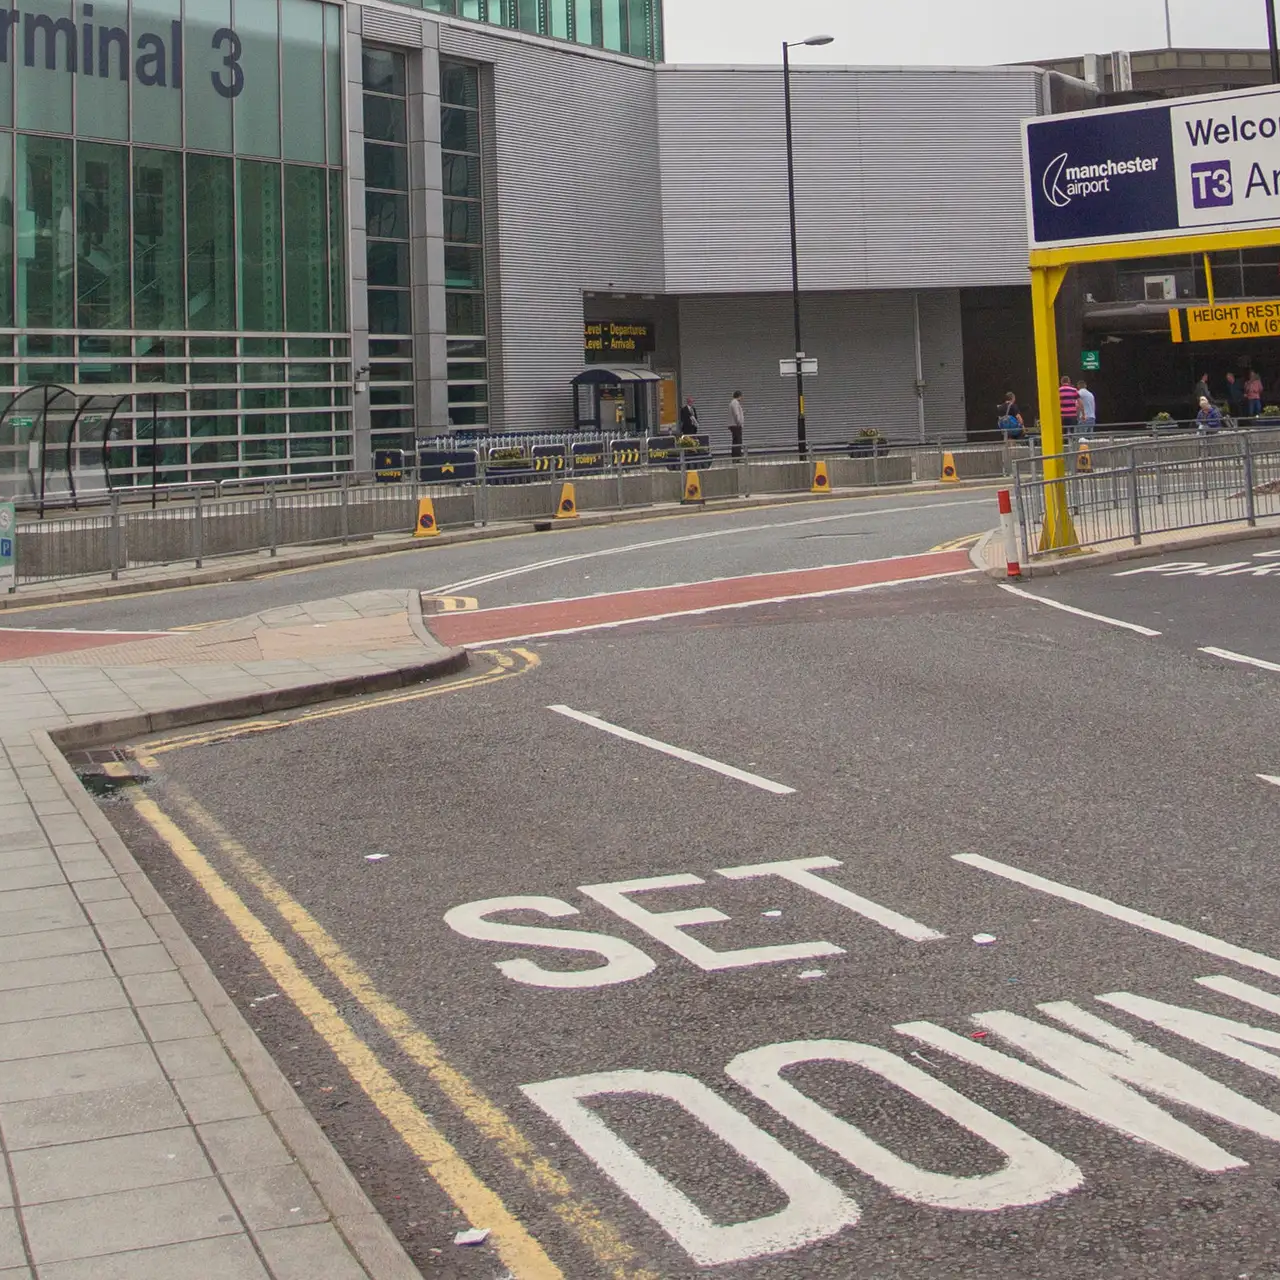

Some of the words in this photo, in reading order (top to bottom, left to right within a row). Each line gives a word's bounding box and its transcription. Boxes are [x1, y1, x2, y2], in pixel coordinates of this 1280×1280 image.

[210, 28, 245, 98] 3
[1066, 157, 1158, 180] manchester
[1067, 177, 1110, 197] airport
[1192, 169, 1232, 199] T3
[1194, 306, 1241, 322] HEIGHT
[610, 323, 647, 337] Departures
[1230, 321, 1259, 335] 2.0M
[611, 338, 635, 350] Arrivals
[443, 853, 948, 988] SET
